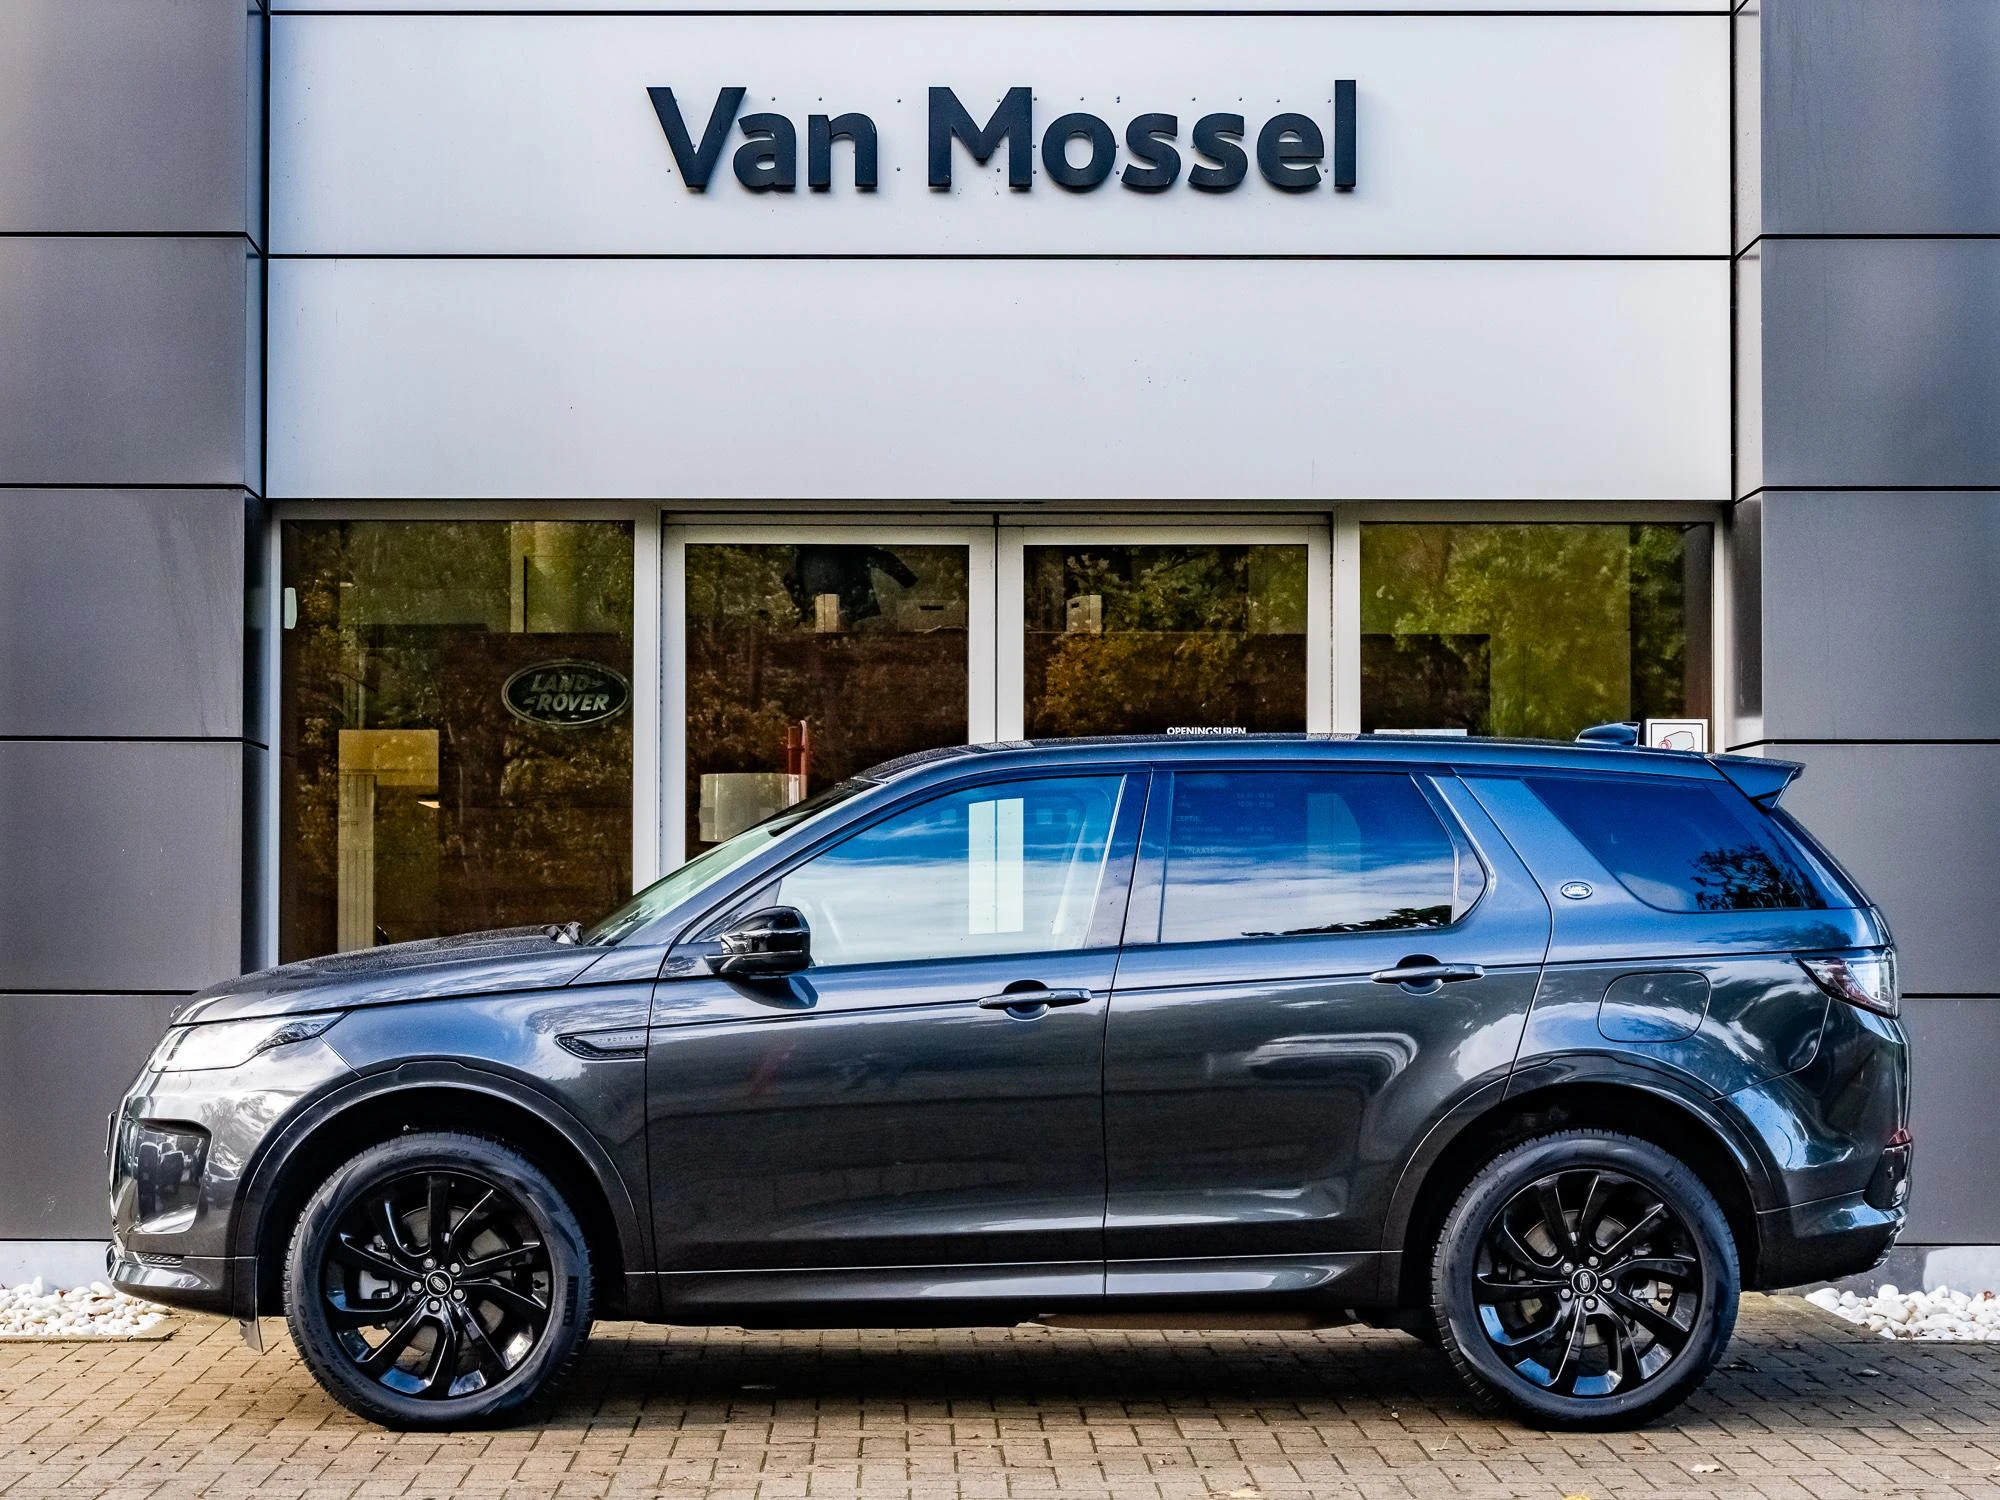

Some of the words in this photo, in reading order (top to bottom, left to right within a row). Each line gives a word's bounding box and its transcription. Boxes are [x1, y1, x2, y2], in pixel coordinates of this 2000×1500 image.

[646, 86, 878, 192] Van
[928, 79, 1357, 193] Mossel
[530, 674, 590, 692] LAND
[535, 693, 610, 711] ROVER
[1166, 726, 1247, 735] OPENINGSUREN
